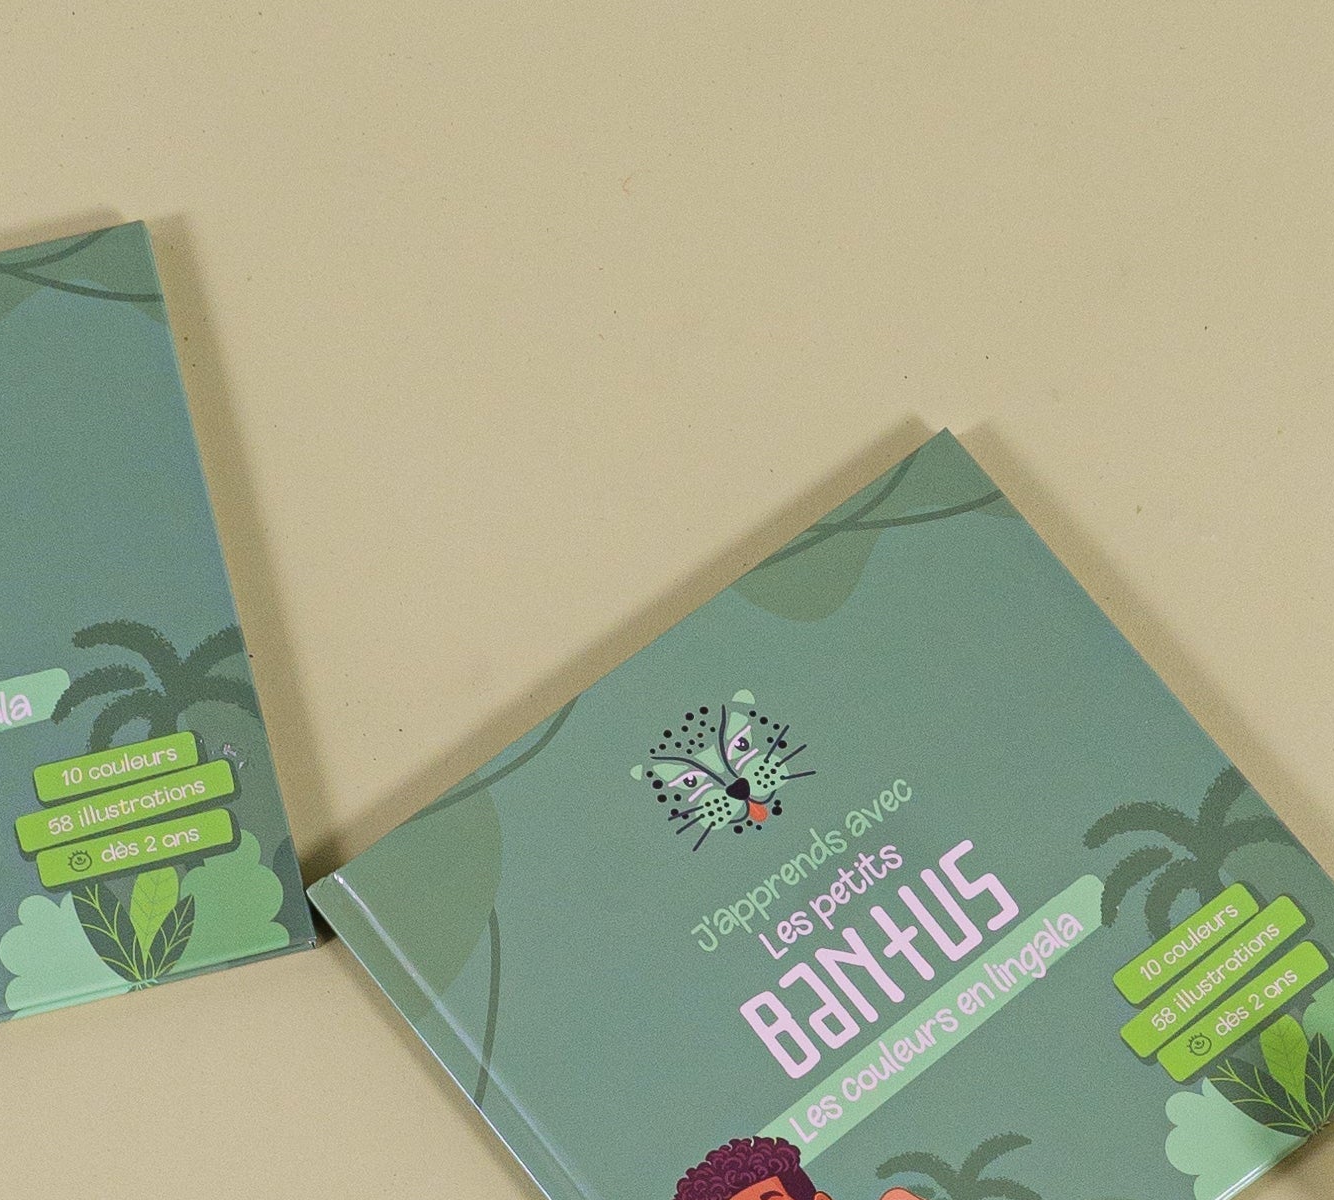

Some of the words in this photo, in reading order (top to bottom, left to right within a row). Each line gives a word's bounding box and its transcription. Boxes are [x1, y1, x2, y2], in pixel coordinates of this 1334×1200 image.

[61, 766, 82, 786] 10
[85, 744, 178, 782] couleurs
[47, 812, 74, 834] 58
[77, 776, 207, 830] illustrations
[102, 839, 135, 864] dès
[144, 835, 157, 853] 2
[162, 826, 200, 849] ans
[691, 823, 847, 952] J'apprends
[843, 778, 913, 839] avec
[758, 911, 815, 960] Les
[808, 842, 905, 919] petits
[1139, 956, 1164, 981] 10
[1161, 902, 1240, 966] couleurs
[1150, 1004, 1179, 1030] 58
[1172, 919, 1281, 1016] illustrations
[788, 1092, 844, 1144] Les
[840, 1008, 959, 1101] couleurs
[956, 983, 996, 1016] en
[991, 909, 1085, 995] lingala
[1213, 1004, 1250, 1038] dès
[1247, 994, 1264, 1012] 2
[1262, 966, 1298, 1001] ans
